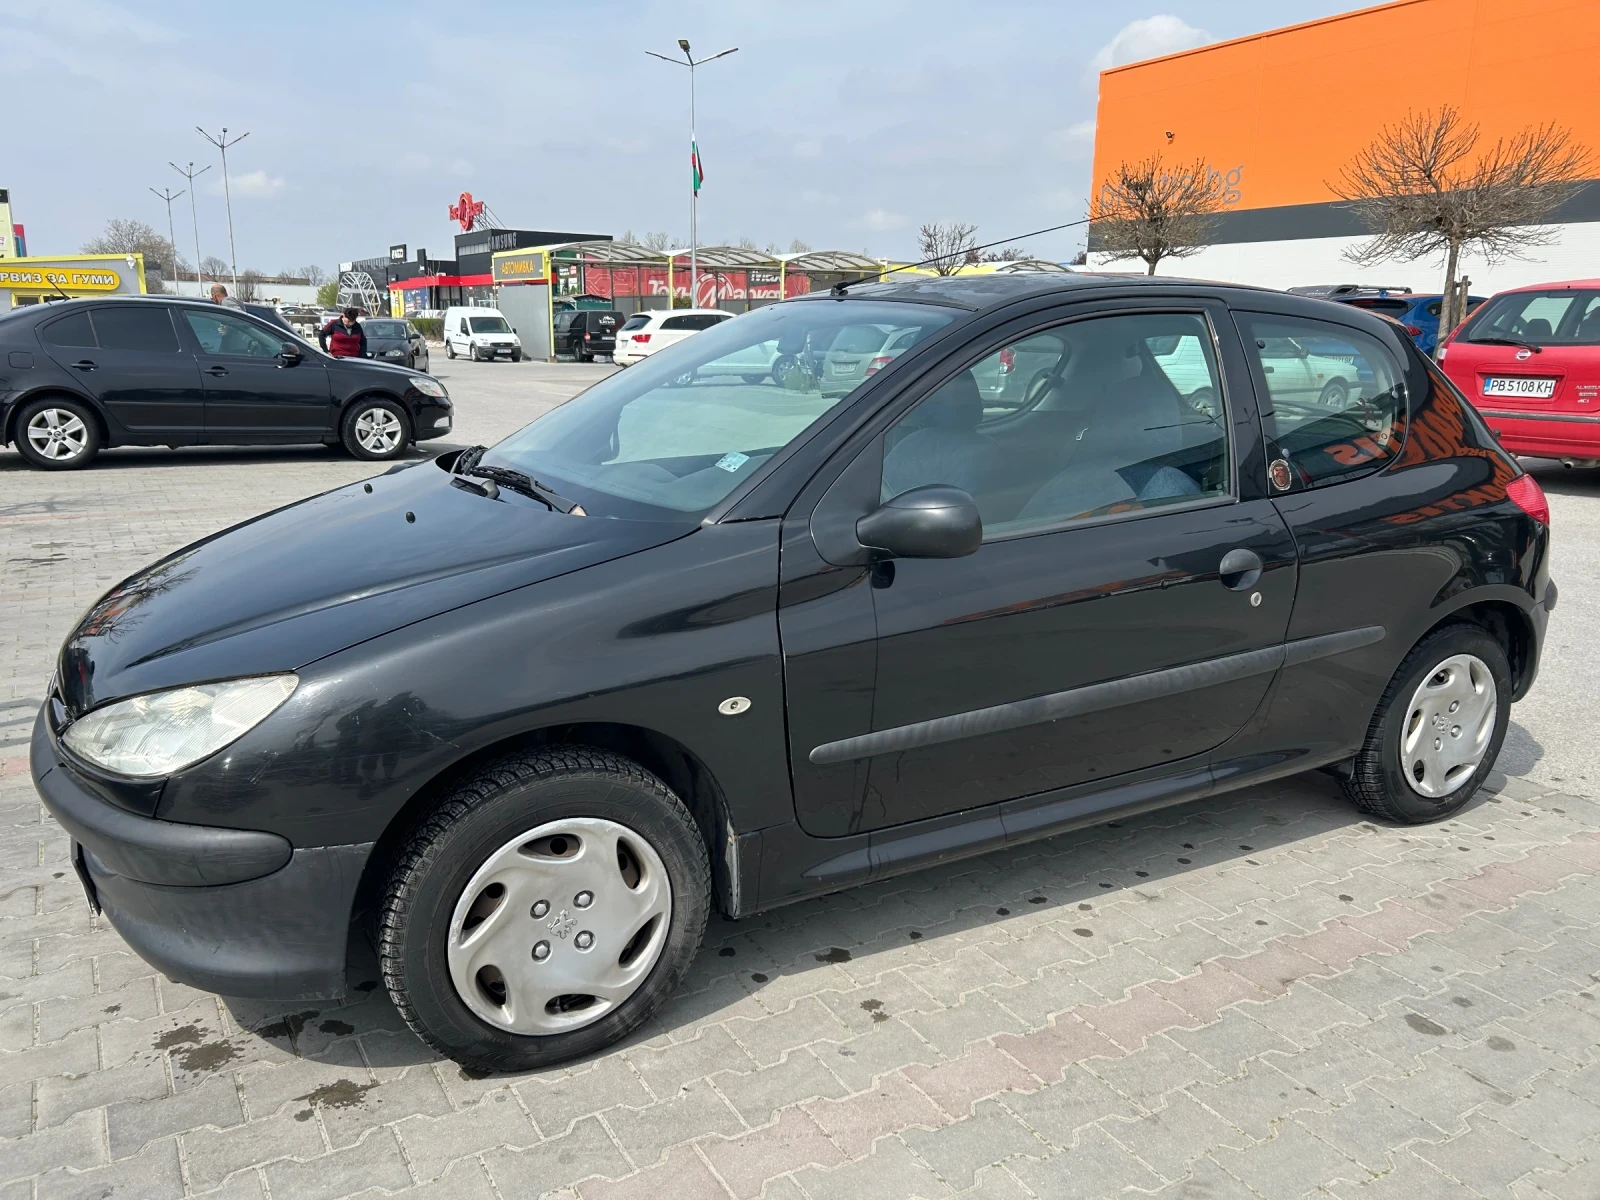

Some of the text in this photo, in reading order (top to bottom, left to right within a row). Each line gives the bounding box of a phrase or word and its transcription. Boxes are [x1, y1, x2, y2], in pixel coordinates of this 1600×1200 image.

[488, 232, 517, 250] SAMSUNG
[46, 273, 69, 284] ЗА
[72, 274, 115, 286] ГУМИ
[1490, 380, 1553, 393] PB 5108 KH
